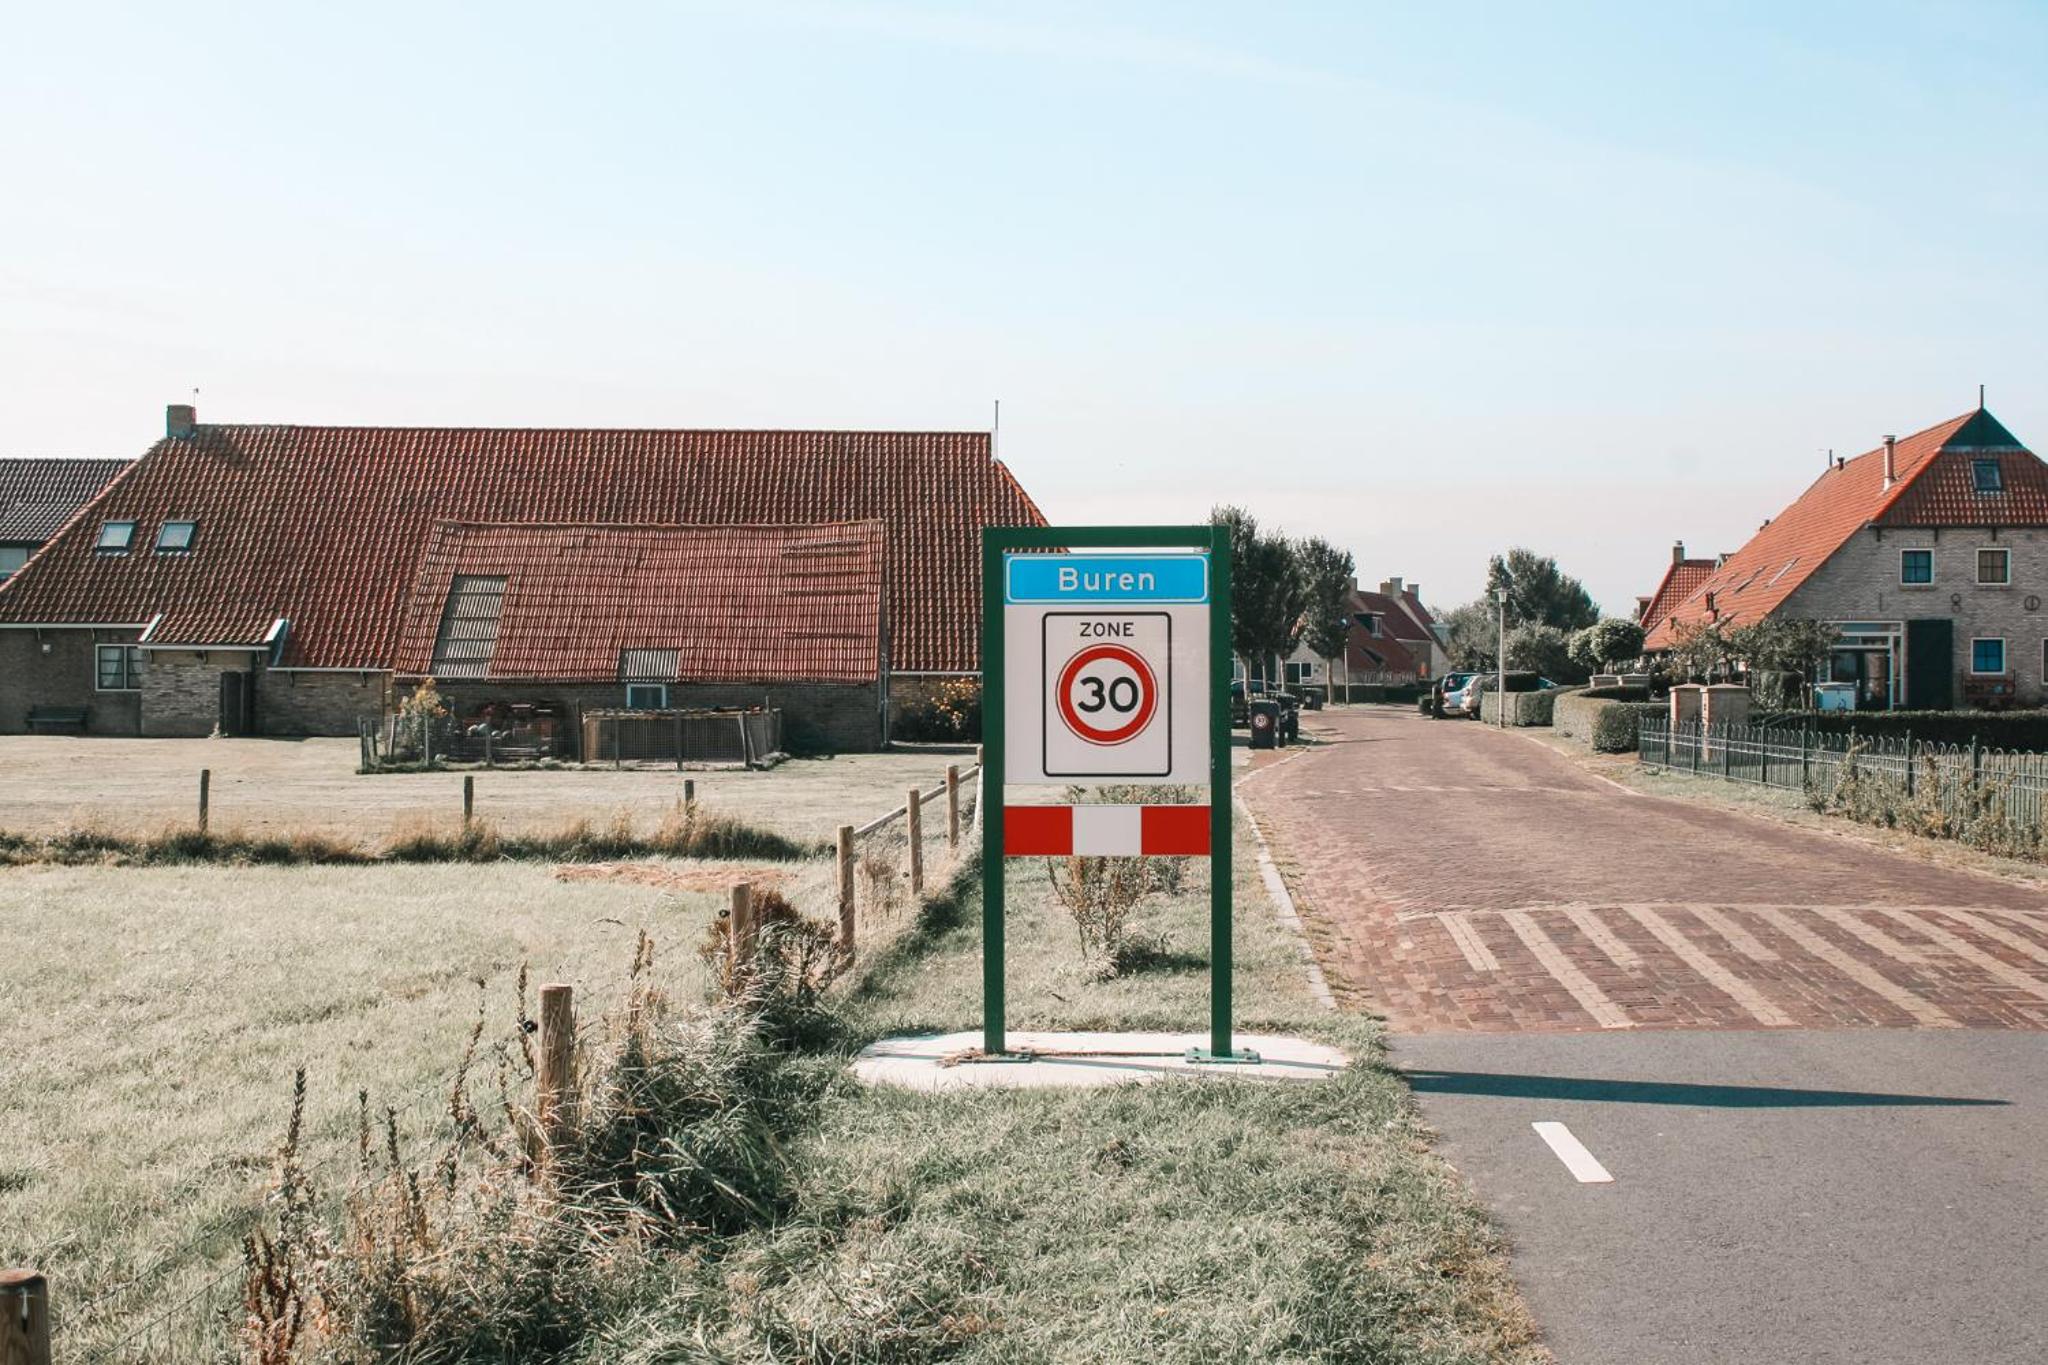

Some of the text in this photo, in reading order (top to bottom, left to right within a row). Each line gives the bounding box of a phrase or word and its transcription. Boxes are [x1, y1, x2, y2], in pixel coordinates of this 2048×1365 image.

[1059, 567, 1155, 592] Buren
[1080, 621, 1135, 638] ZONE
[1077, 676, 1139, 713] 30
